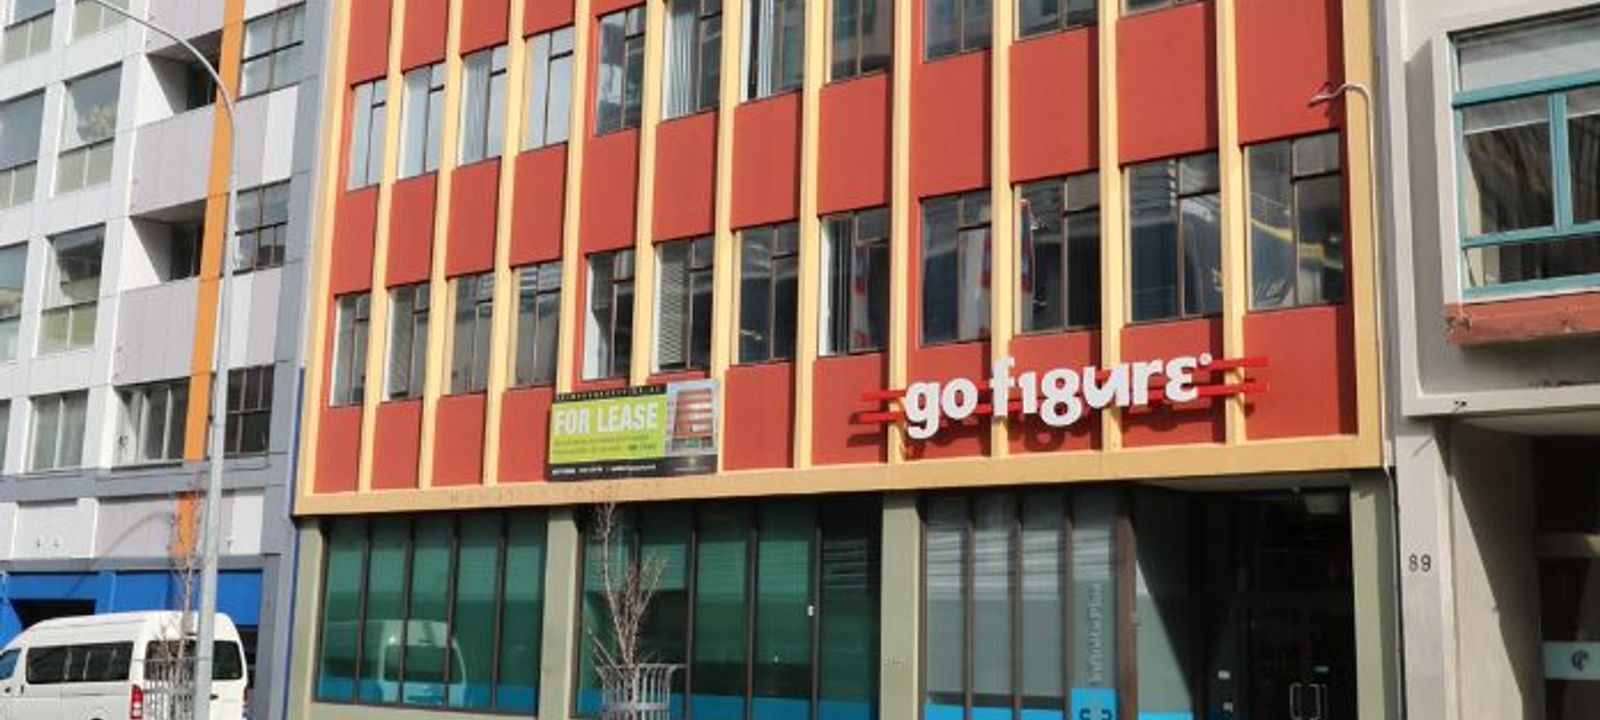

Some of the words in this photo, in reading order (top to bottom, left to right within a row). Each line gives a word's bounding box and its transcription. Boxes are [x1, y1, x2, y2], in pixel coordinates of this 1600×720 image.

[904, 376, 979, 440] go
[991, 353, 1199, 428] figure
[554, 407, 590, 437] FOR
[597, 402, 659, 433] LEASE
[1408, 552, 1431, 572] 89
